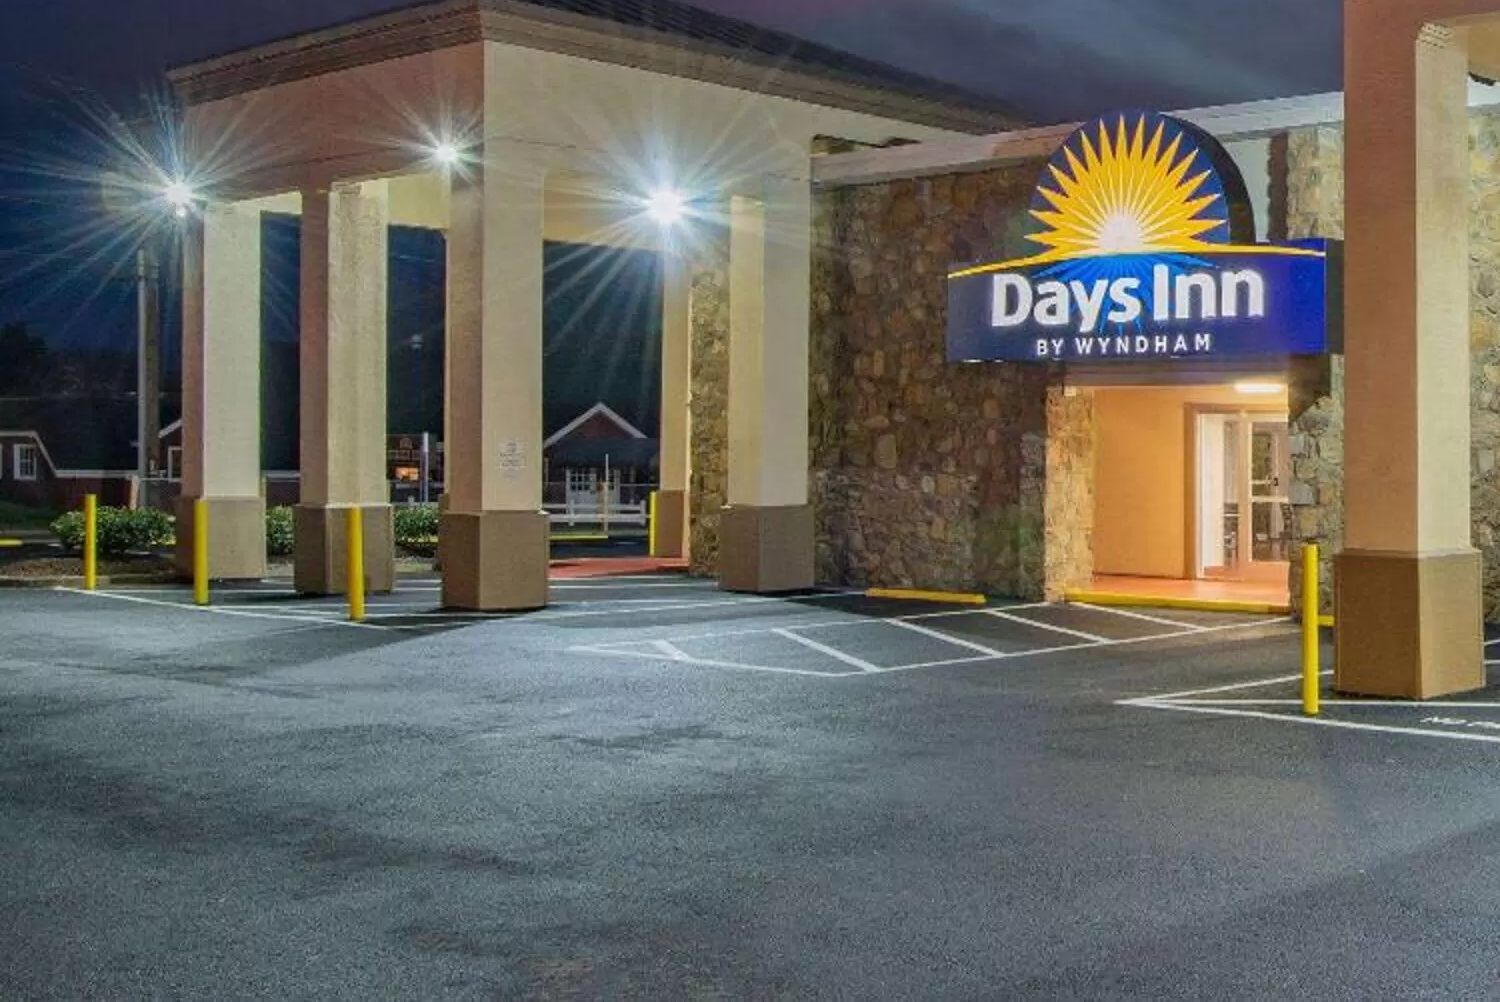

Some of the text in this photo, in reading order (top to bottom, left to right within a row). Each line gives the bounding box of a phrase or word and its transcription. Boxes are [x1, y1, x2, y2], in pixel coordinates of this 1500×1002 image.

[991, 263, 1264, 333] Days Inn
[1036, 333, 1211, 356] BY WYNDHAM
